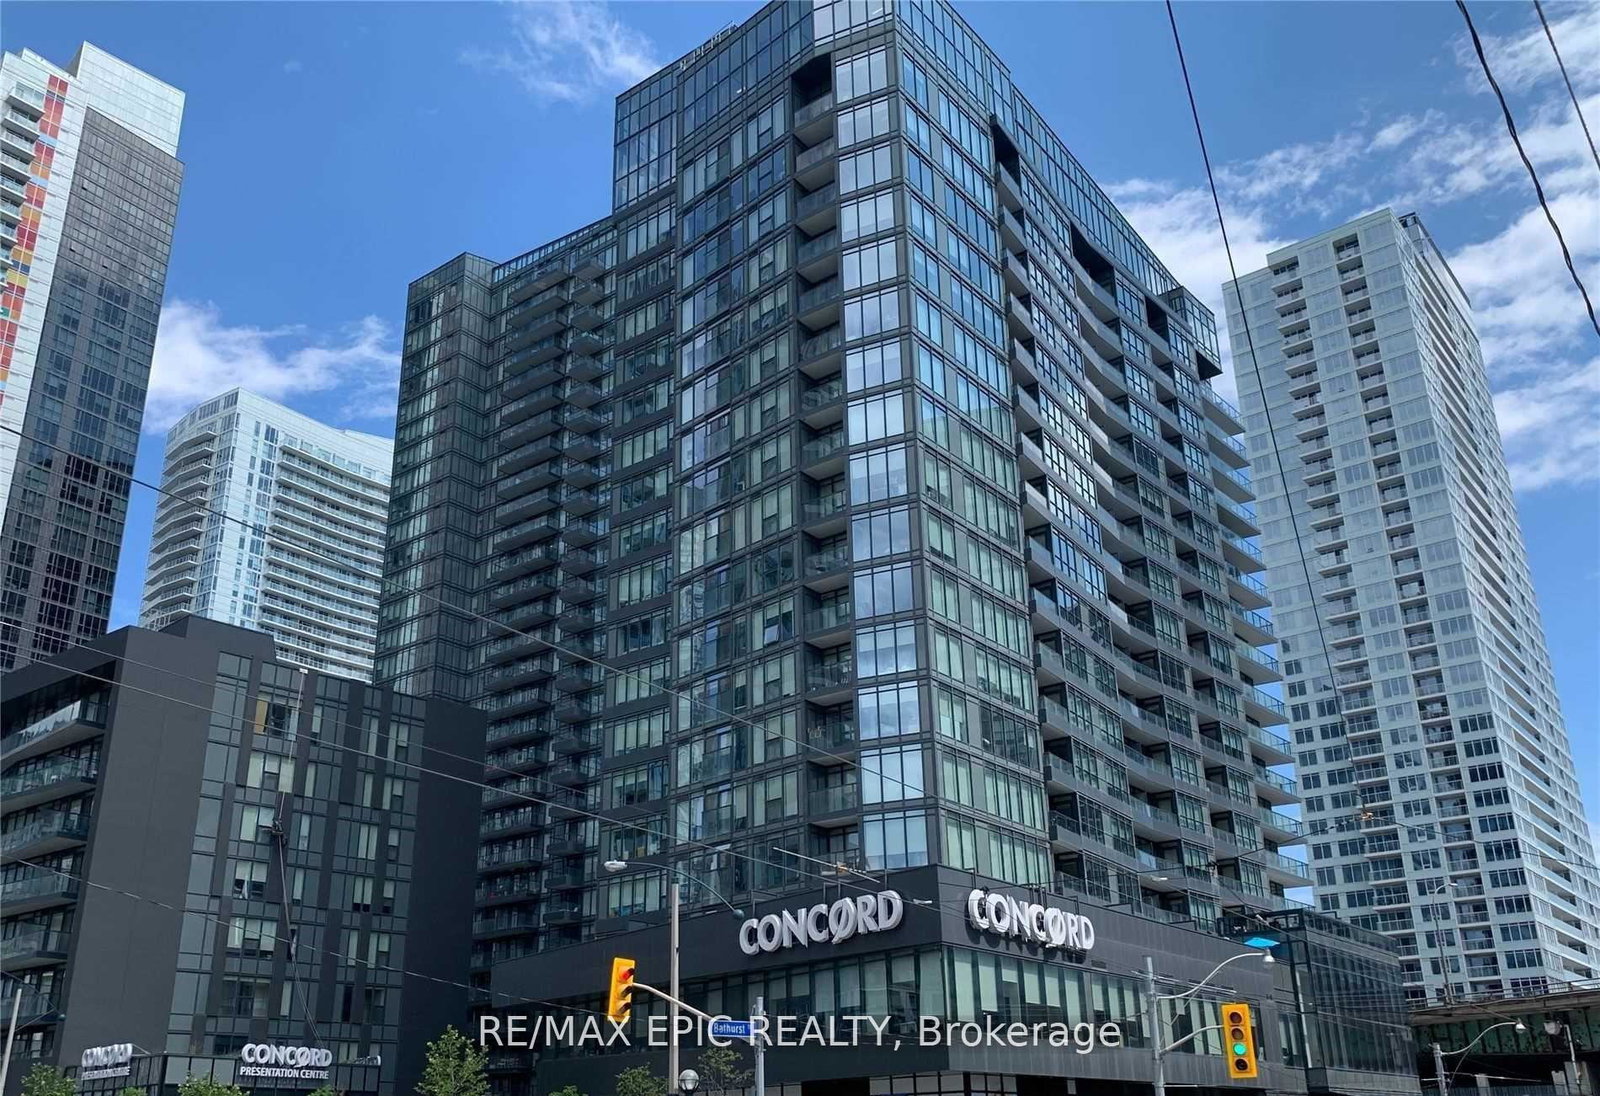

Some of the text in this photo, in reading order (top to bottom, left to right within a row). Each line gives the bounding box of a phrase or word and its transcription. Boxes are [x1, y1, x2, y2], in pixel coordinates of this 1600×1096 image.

[713, 1022, 745, 1034] Bathurst
[240, 1066, 329, 1079] PRESENTATION CENTRE
